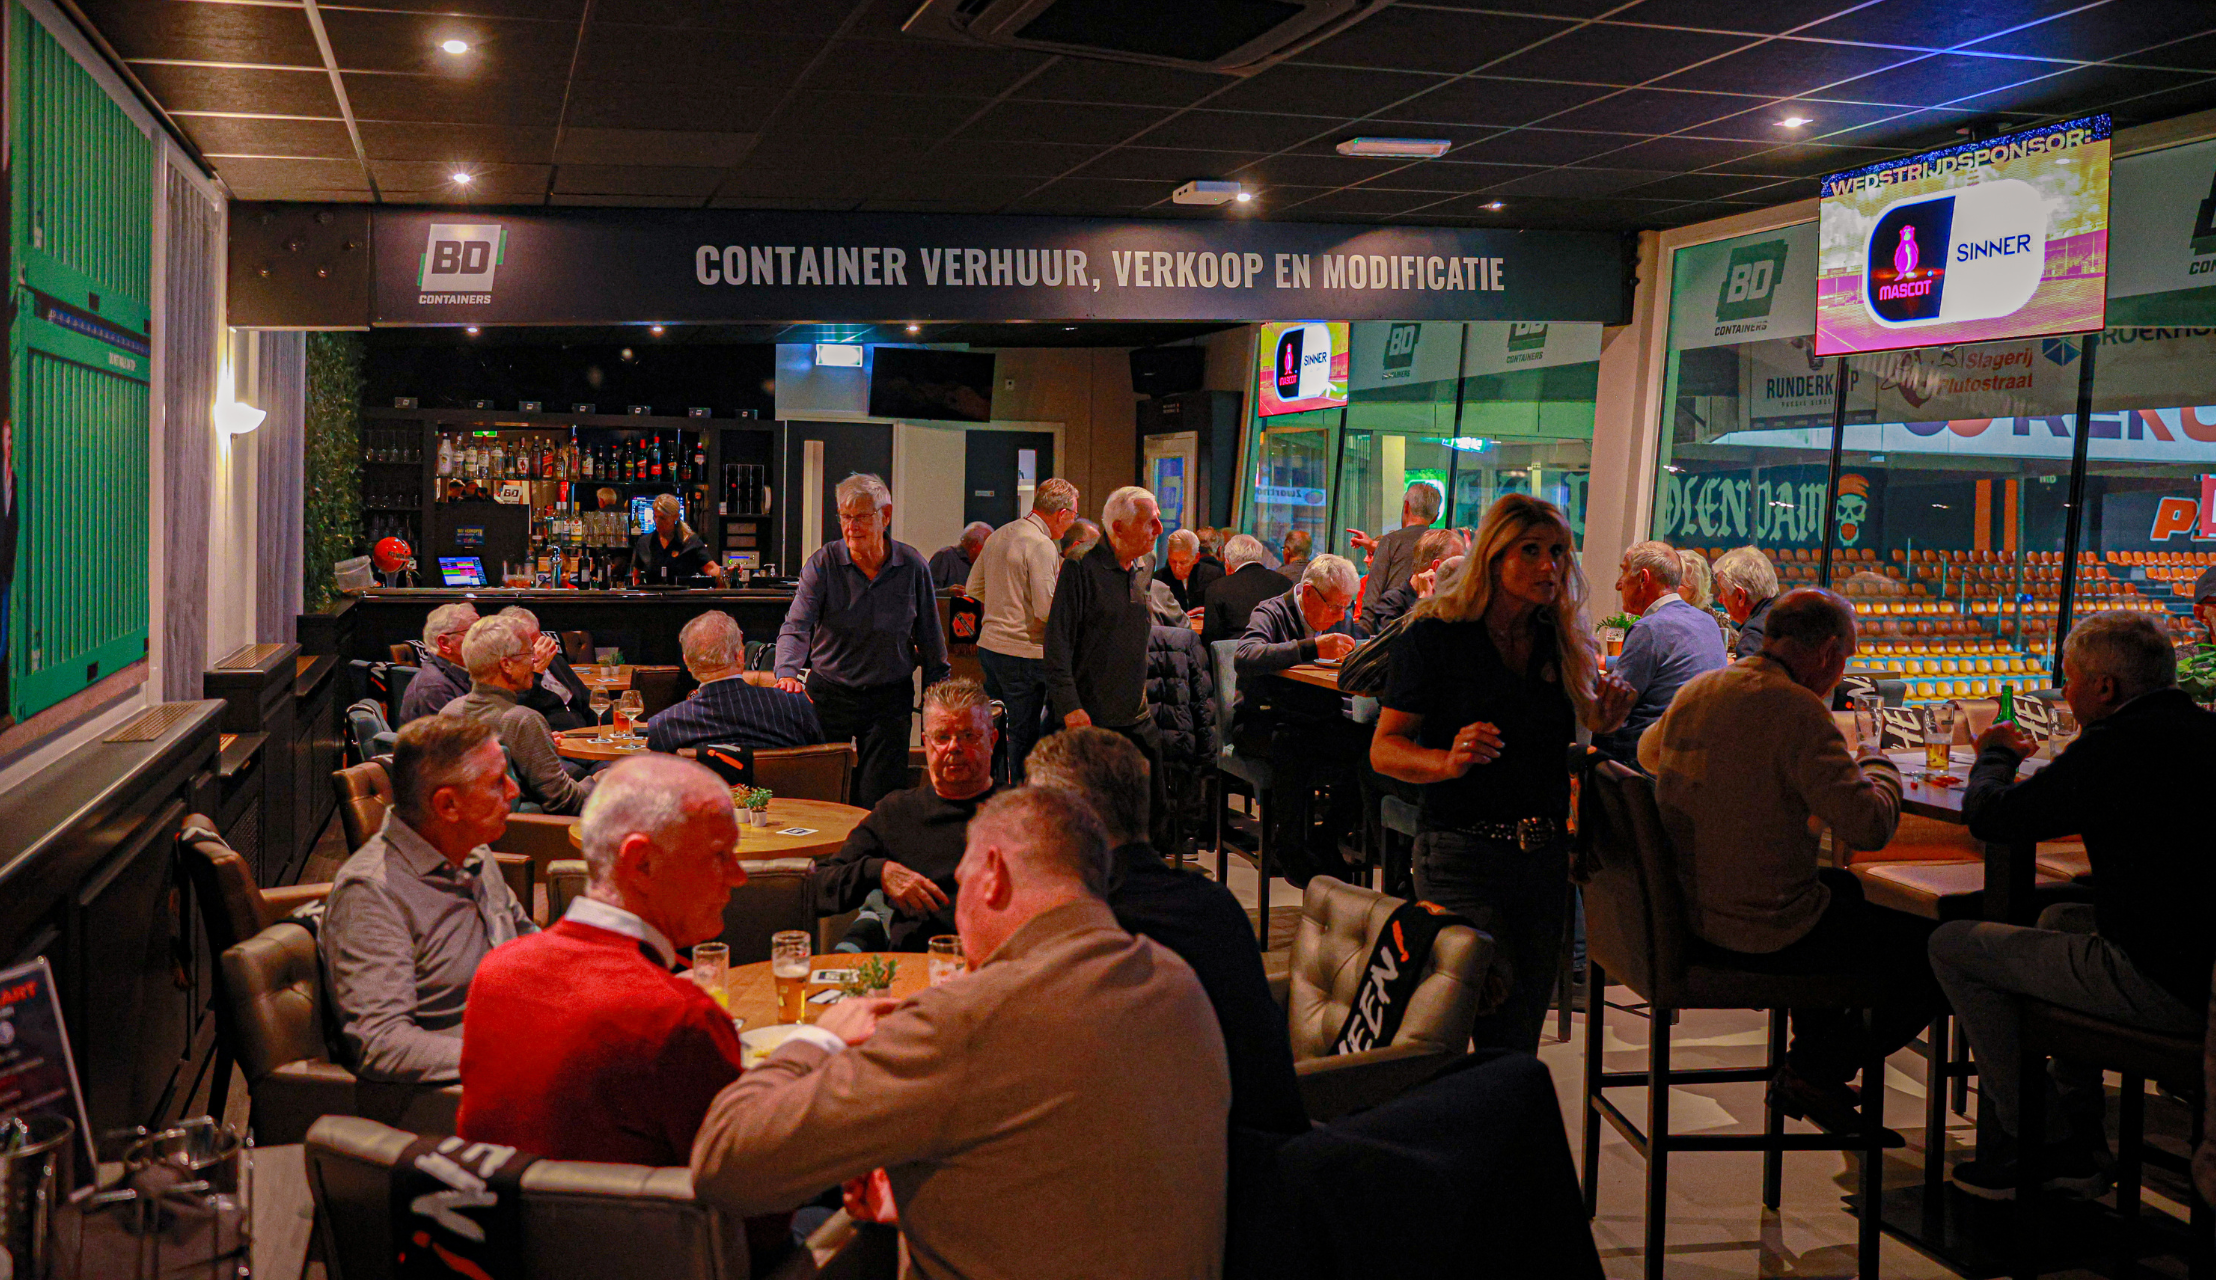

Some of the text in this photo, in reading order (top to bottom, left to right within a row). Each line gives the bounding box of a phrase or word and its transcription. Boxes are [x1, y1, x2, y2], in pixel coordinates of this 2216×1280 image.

[1829, 129, 2093, 197] WEDSTRIJDSPONSOR:
[431, 241, 491, 274] BD
[1956, 234, 2031, 263] SINNER
[695, 245, 1505, 293] CONTAINER VERHUUR, VERKOOP EN MODIFICATIE
[1727, 259, 1775, 304] BD
[418, 294, 492, 305] CONTAINERS
[1879, 279, 1932, 301] MASCOT
[1389, 325, 1416, 356] BD
[1714, 321, 1768, 337] CONTAINERS
[1303, 351, 1327, 366] SINNER
[1965, 348, 2033, 371] Slagerij
[1766, 370, 1860, 399] RUNDERKP
